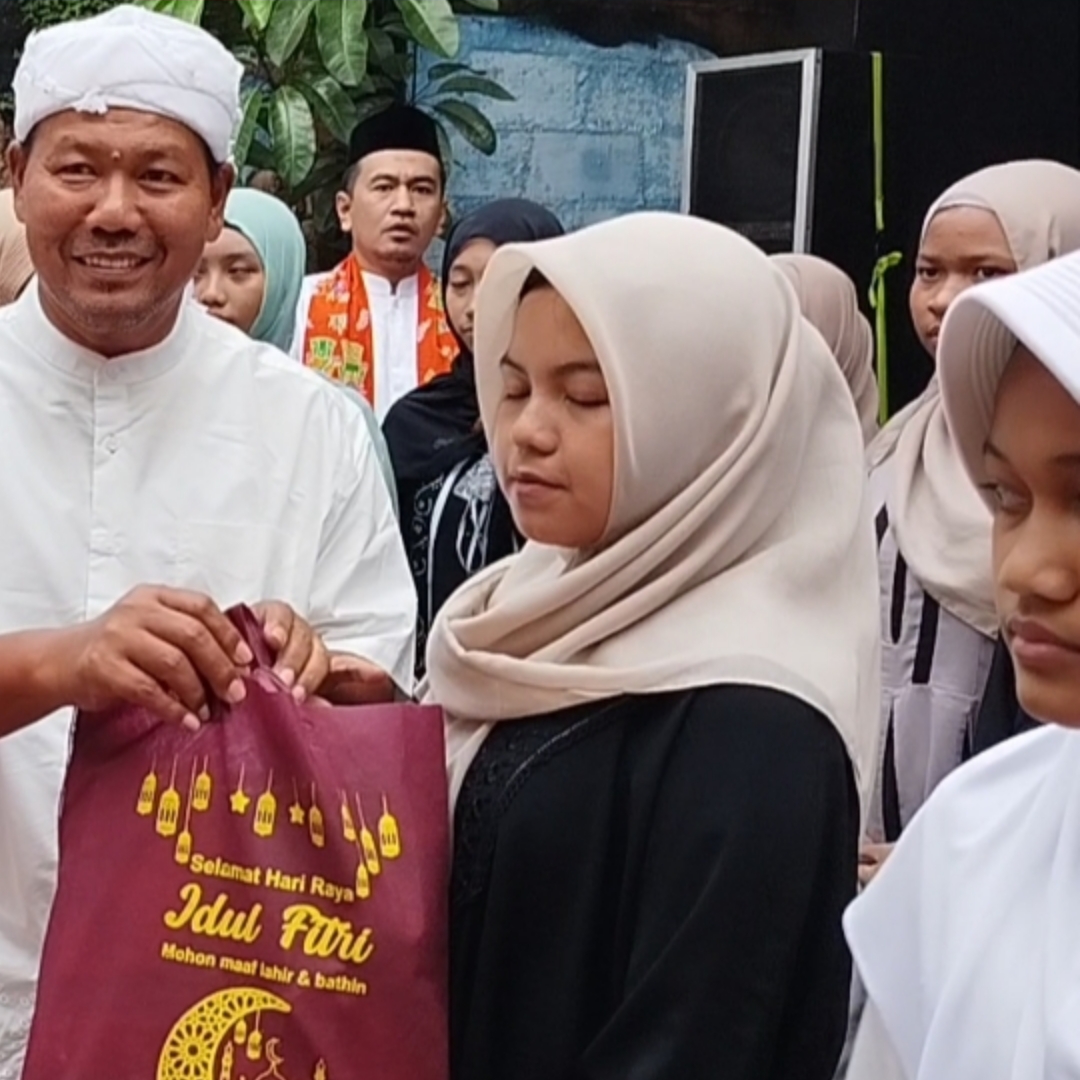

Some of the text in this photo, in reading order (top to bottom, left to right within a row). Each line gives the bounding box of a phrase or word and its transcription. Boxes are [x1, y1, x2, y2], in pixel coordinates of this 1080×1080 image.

[190, 853, 355, 903] Selamat Hari Raya
[163, 882, 374, 963] Idul Fitri
[161, 942, 368, 995] Mohon maaf lahir & bathin
